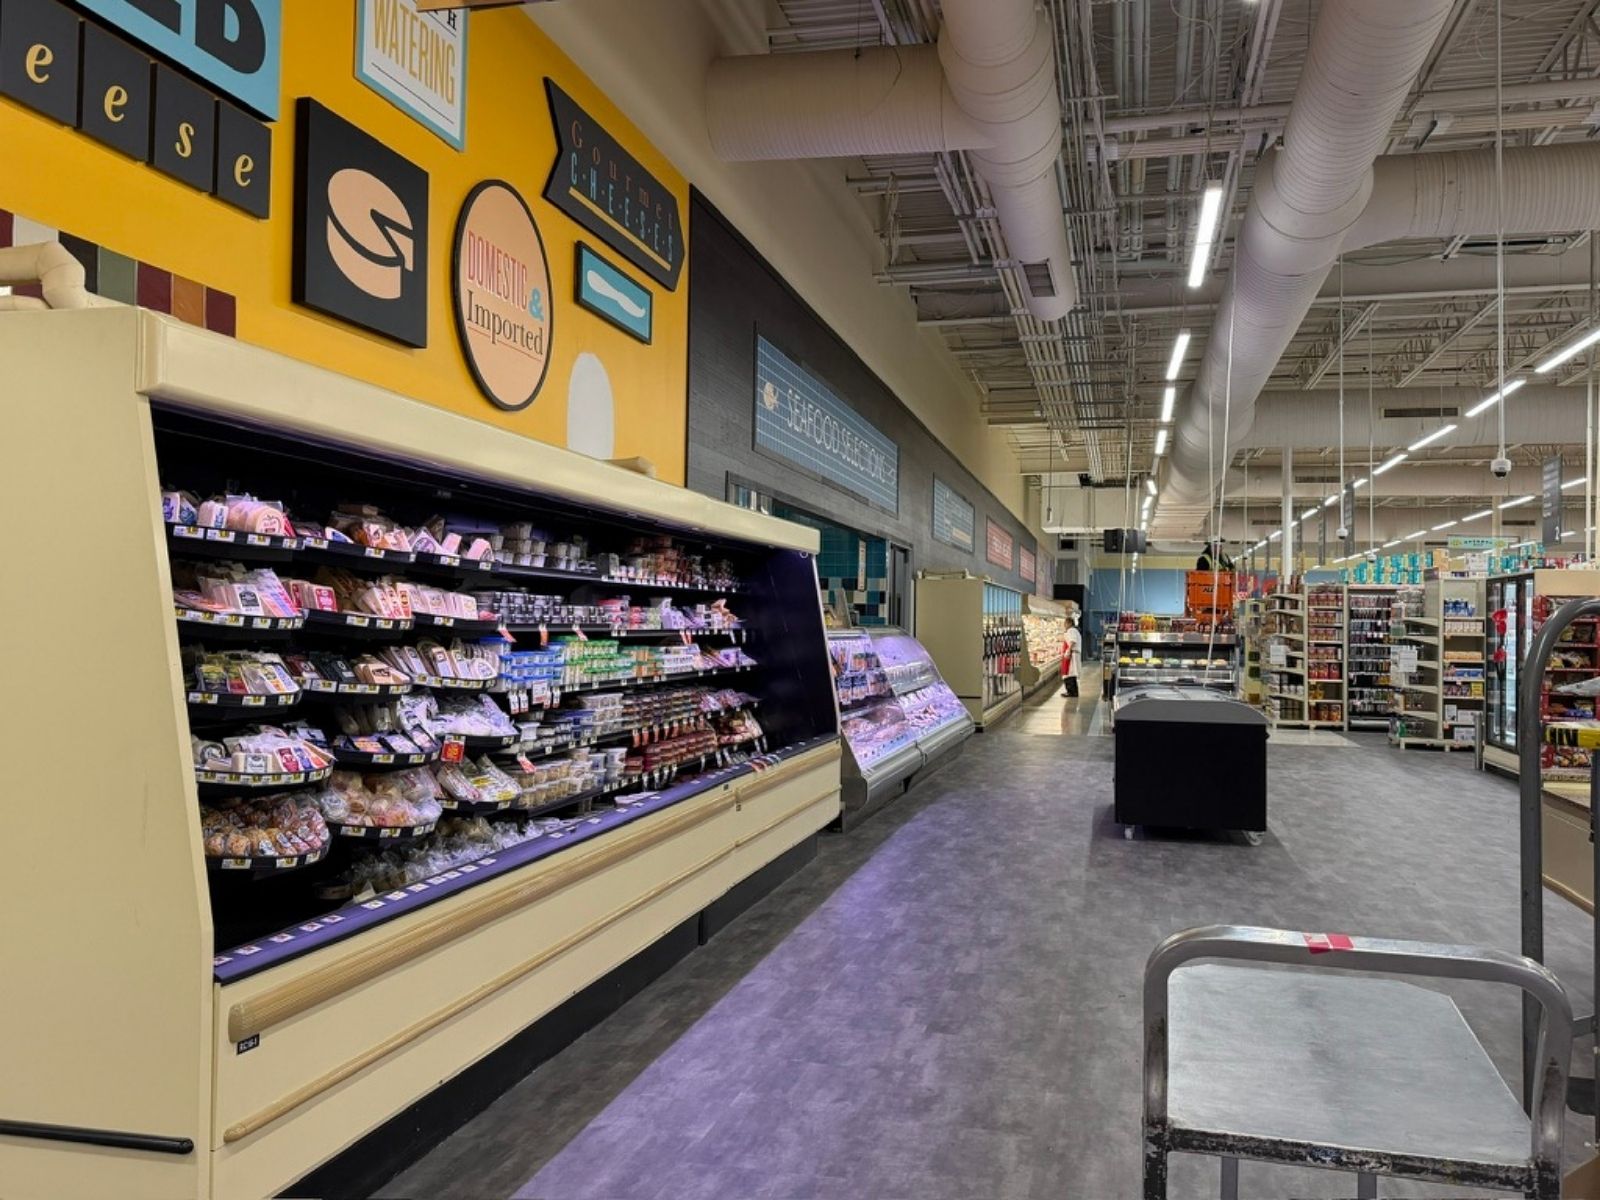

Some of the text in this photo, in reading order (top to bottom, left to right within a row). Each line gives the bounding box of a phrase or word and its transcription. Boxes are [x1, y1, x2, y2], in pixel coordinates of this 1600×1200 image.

[571, 119, 673, 230] Gourmet
[467, 230, 545, 322] DOMESTIC &
[466, 289, 544, 356] Imported
[787, 389, 840, 454] SEAFOOD
